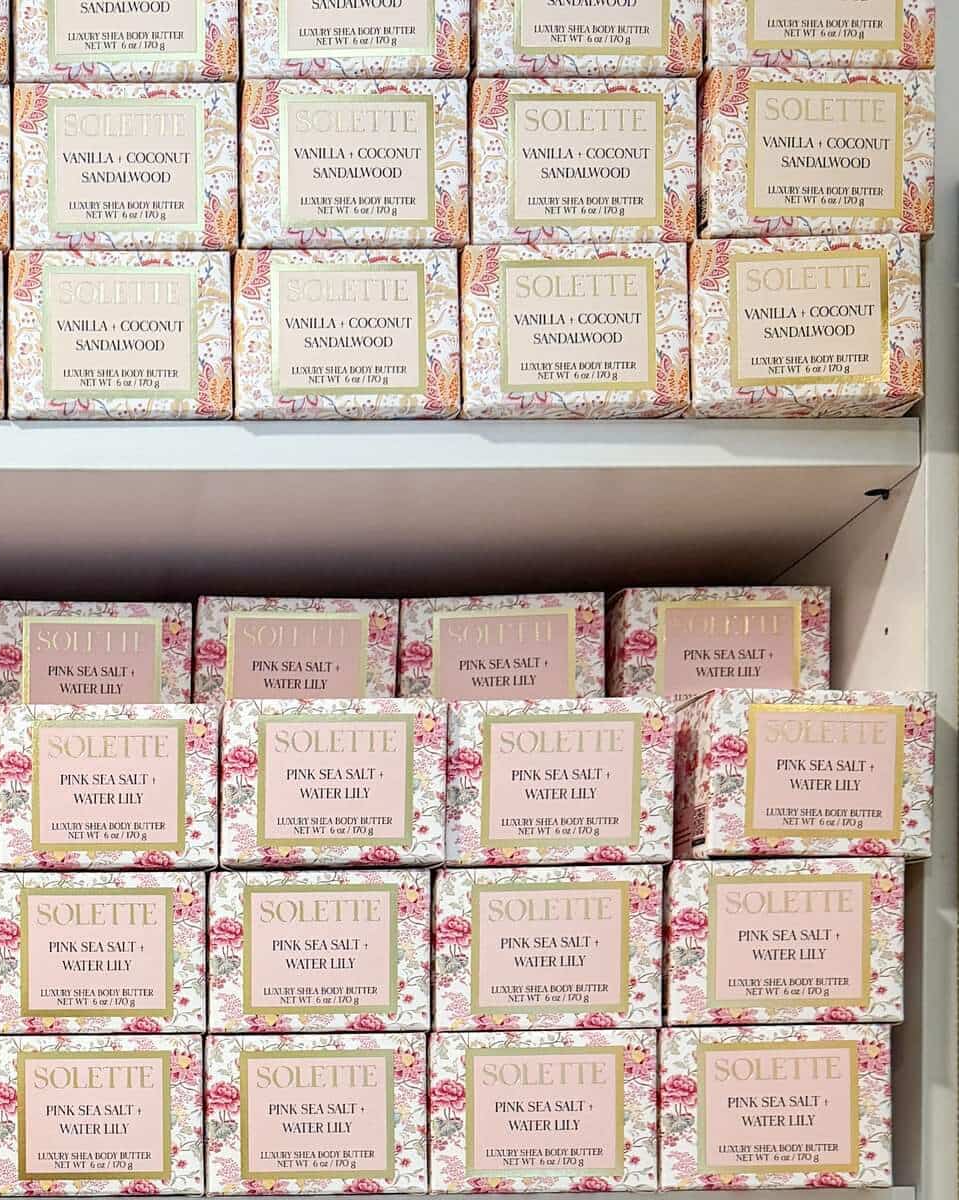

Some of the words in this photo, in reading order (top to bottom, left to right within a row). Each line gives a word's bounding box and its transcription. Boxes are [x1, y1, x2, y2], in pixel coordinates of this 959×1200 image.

[80, 1, 170, 14] SANDALWOOD
[767, 20, 799, 28] LUXURY
[802, 20, 823, 28] SHEA
[826, 20, 849, 28] BODY
[851, 20, 883, 28] BUTTER
[765, 98, 886, 122] SOLETTE
[762, 136, 814, 148] VANILLA
[826, 137, 890, 150] COCONUT
[781, 156, 870, 168] SANDALWOOD
[768, 186, 799, 194] LUXURY
[802, 186, 823, 195] SHEA
[826, 187, 850, 195] BODY
[852, 188, 883, 196] BUTTER
[784, 196, 800, 204] NET
[803, 196, 817, 204] WT
[48, 735, 168, 759] SOLETTE
[60, 774, 89, 785] PINK
[92, 774, 115, 784] SEA
[119, 774, 148, 784] SALT
[74, 793, 115, 804] WATER
[118, 793, 144, 804] LILY
[714, 1057, 842, 1082] SOLETTE
[728, 1097, 758, 1108] PINK
[761, 1096, 786, 1108] SEA
[790, 1096, 820, 1107] SALT
[742, 1115, 785, 1127] WATER
[789, 1115, 815, 1126] LILY
[719, 1145, 752, 1153] LUXURY
[753, 1144, 777, 1152] SHEA
[779, 1144, 803, 1152] BODY
